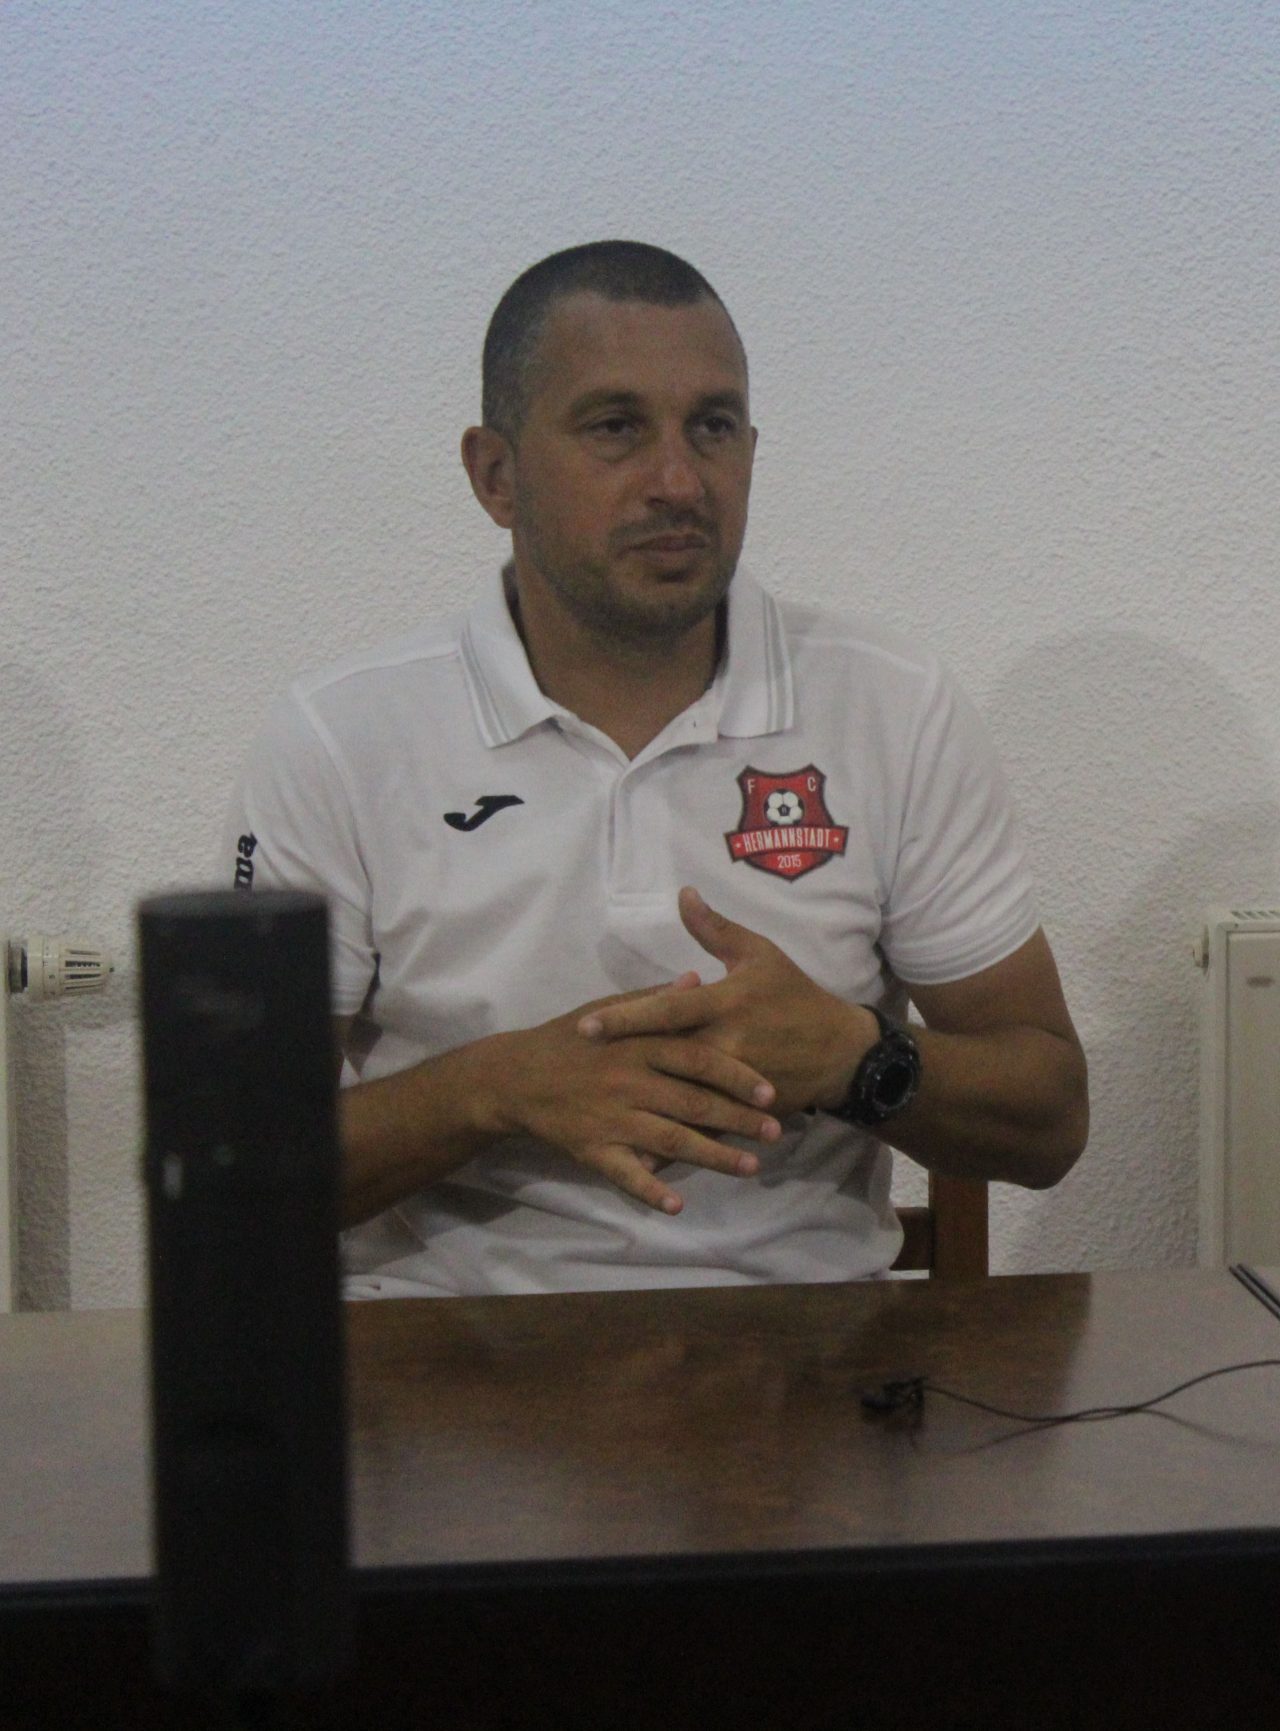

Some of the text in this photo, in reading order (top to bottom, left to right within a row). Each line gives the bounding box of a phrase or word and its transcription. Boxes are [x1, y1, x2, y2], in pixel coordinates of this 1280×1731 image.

[747, 776, 816, 794] F C
[742, 827, 831, 853] HERMANNSTADT
[777, 854, 801, 868] 2015
